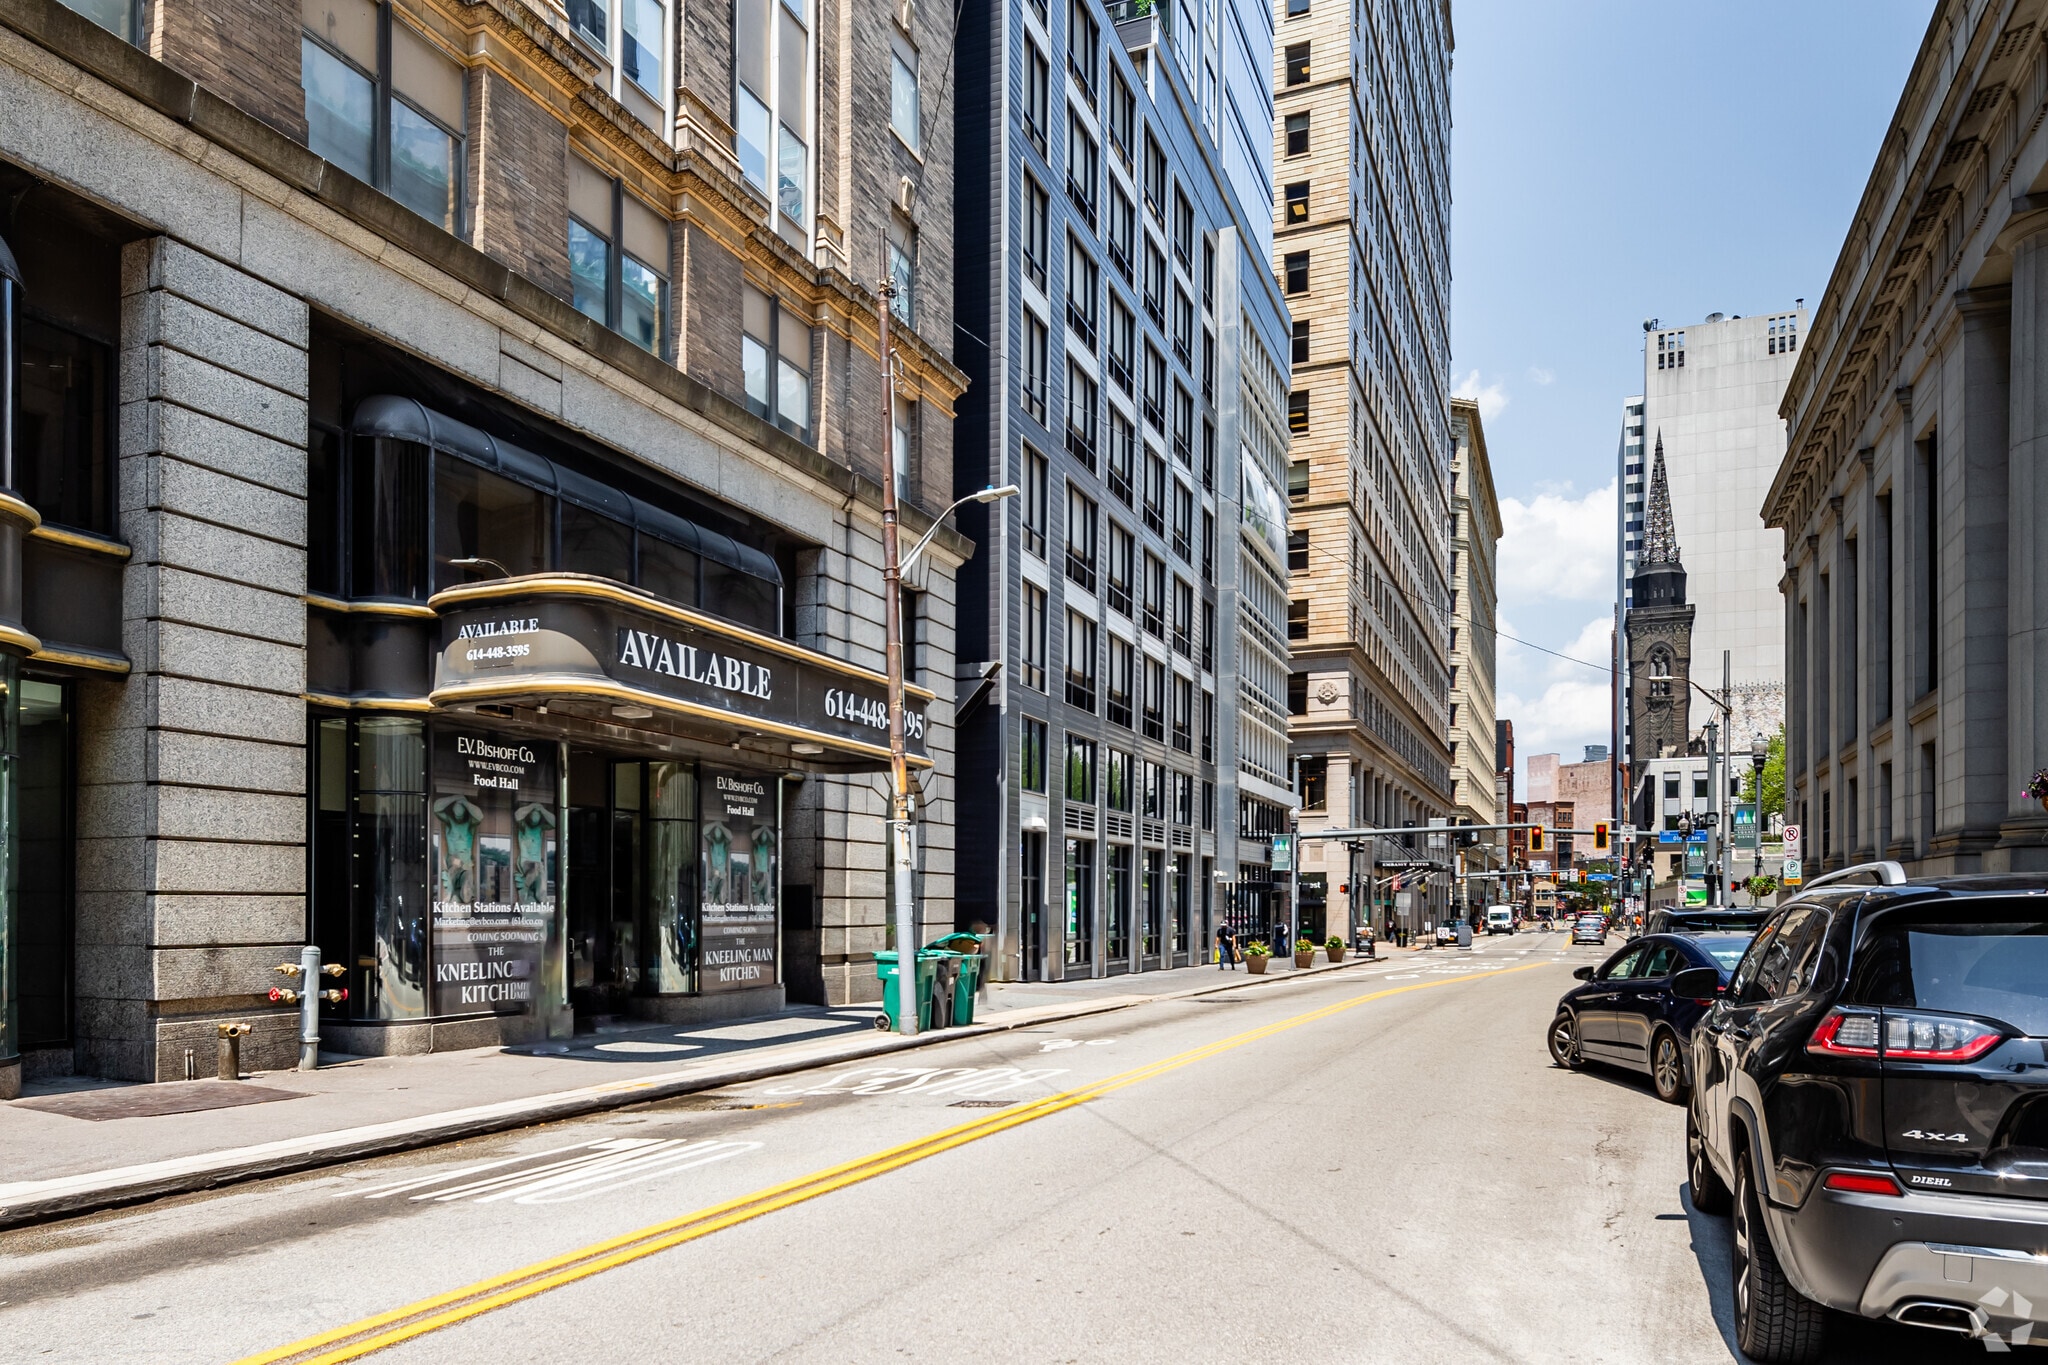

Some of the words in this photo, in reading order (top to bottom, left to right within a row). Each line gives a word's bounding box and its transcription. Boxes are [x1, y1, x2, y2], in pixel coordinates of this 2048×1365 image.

[458, 618, 539, 640] AVAILABLE
[466, 644, 530, 661] 614-448-3595
[620, 629, 772, 700] AVAILABLE
[473, 773, 497, 788] Food
[499, 776, 519, 790] Hall
[727, 804, 741, 815] Food
[742, 806, 755, 816] Hall
[433, 901, 471, 913] Kitchen
[473, 901, 511, 913] Stations
[513, 902, 555, 913] Available
[702, 903, 725, 911] Kitchen
[725, 902, 748, 911] Stations
[749, 903, 775, 911] Available
[467, 932, 500, 941] COMING
[735, 937, 746, 945] THE
[488, 946, 504, 956] THE
[705, 948, 752, 965] KNEELING
[752, 948, 773, 961] MAN
[720, 966, 760, 982] KITCHEN
[1911, 1175, 1952, 1187] DIEHL
